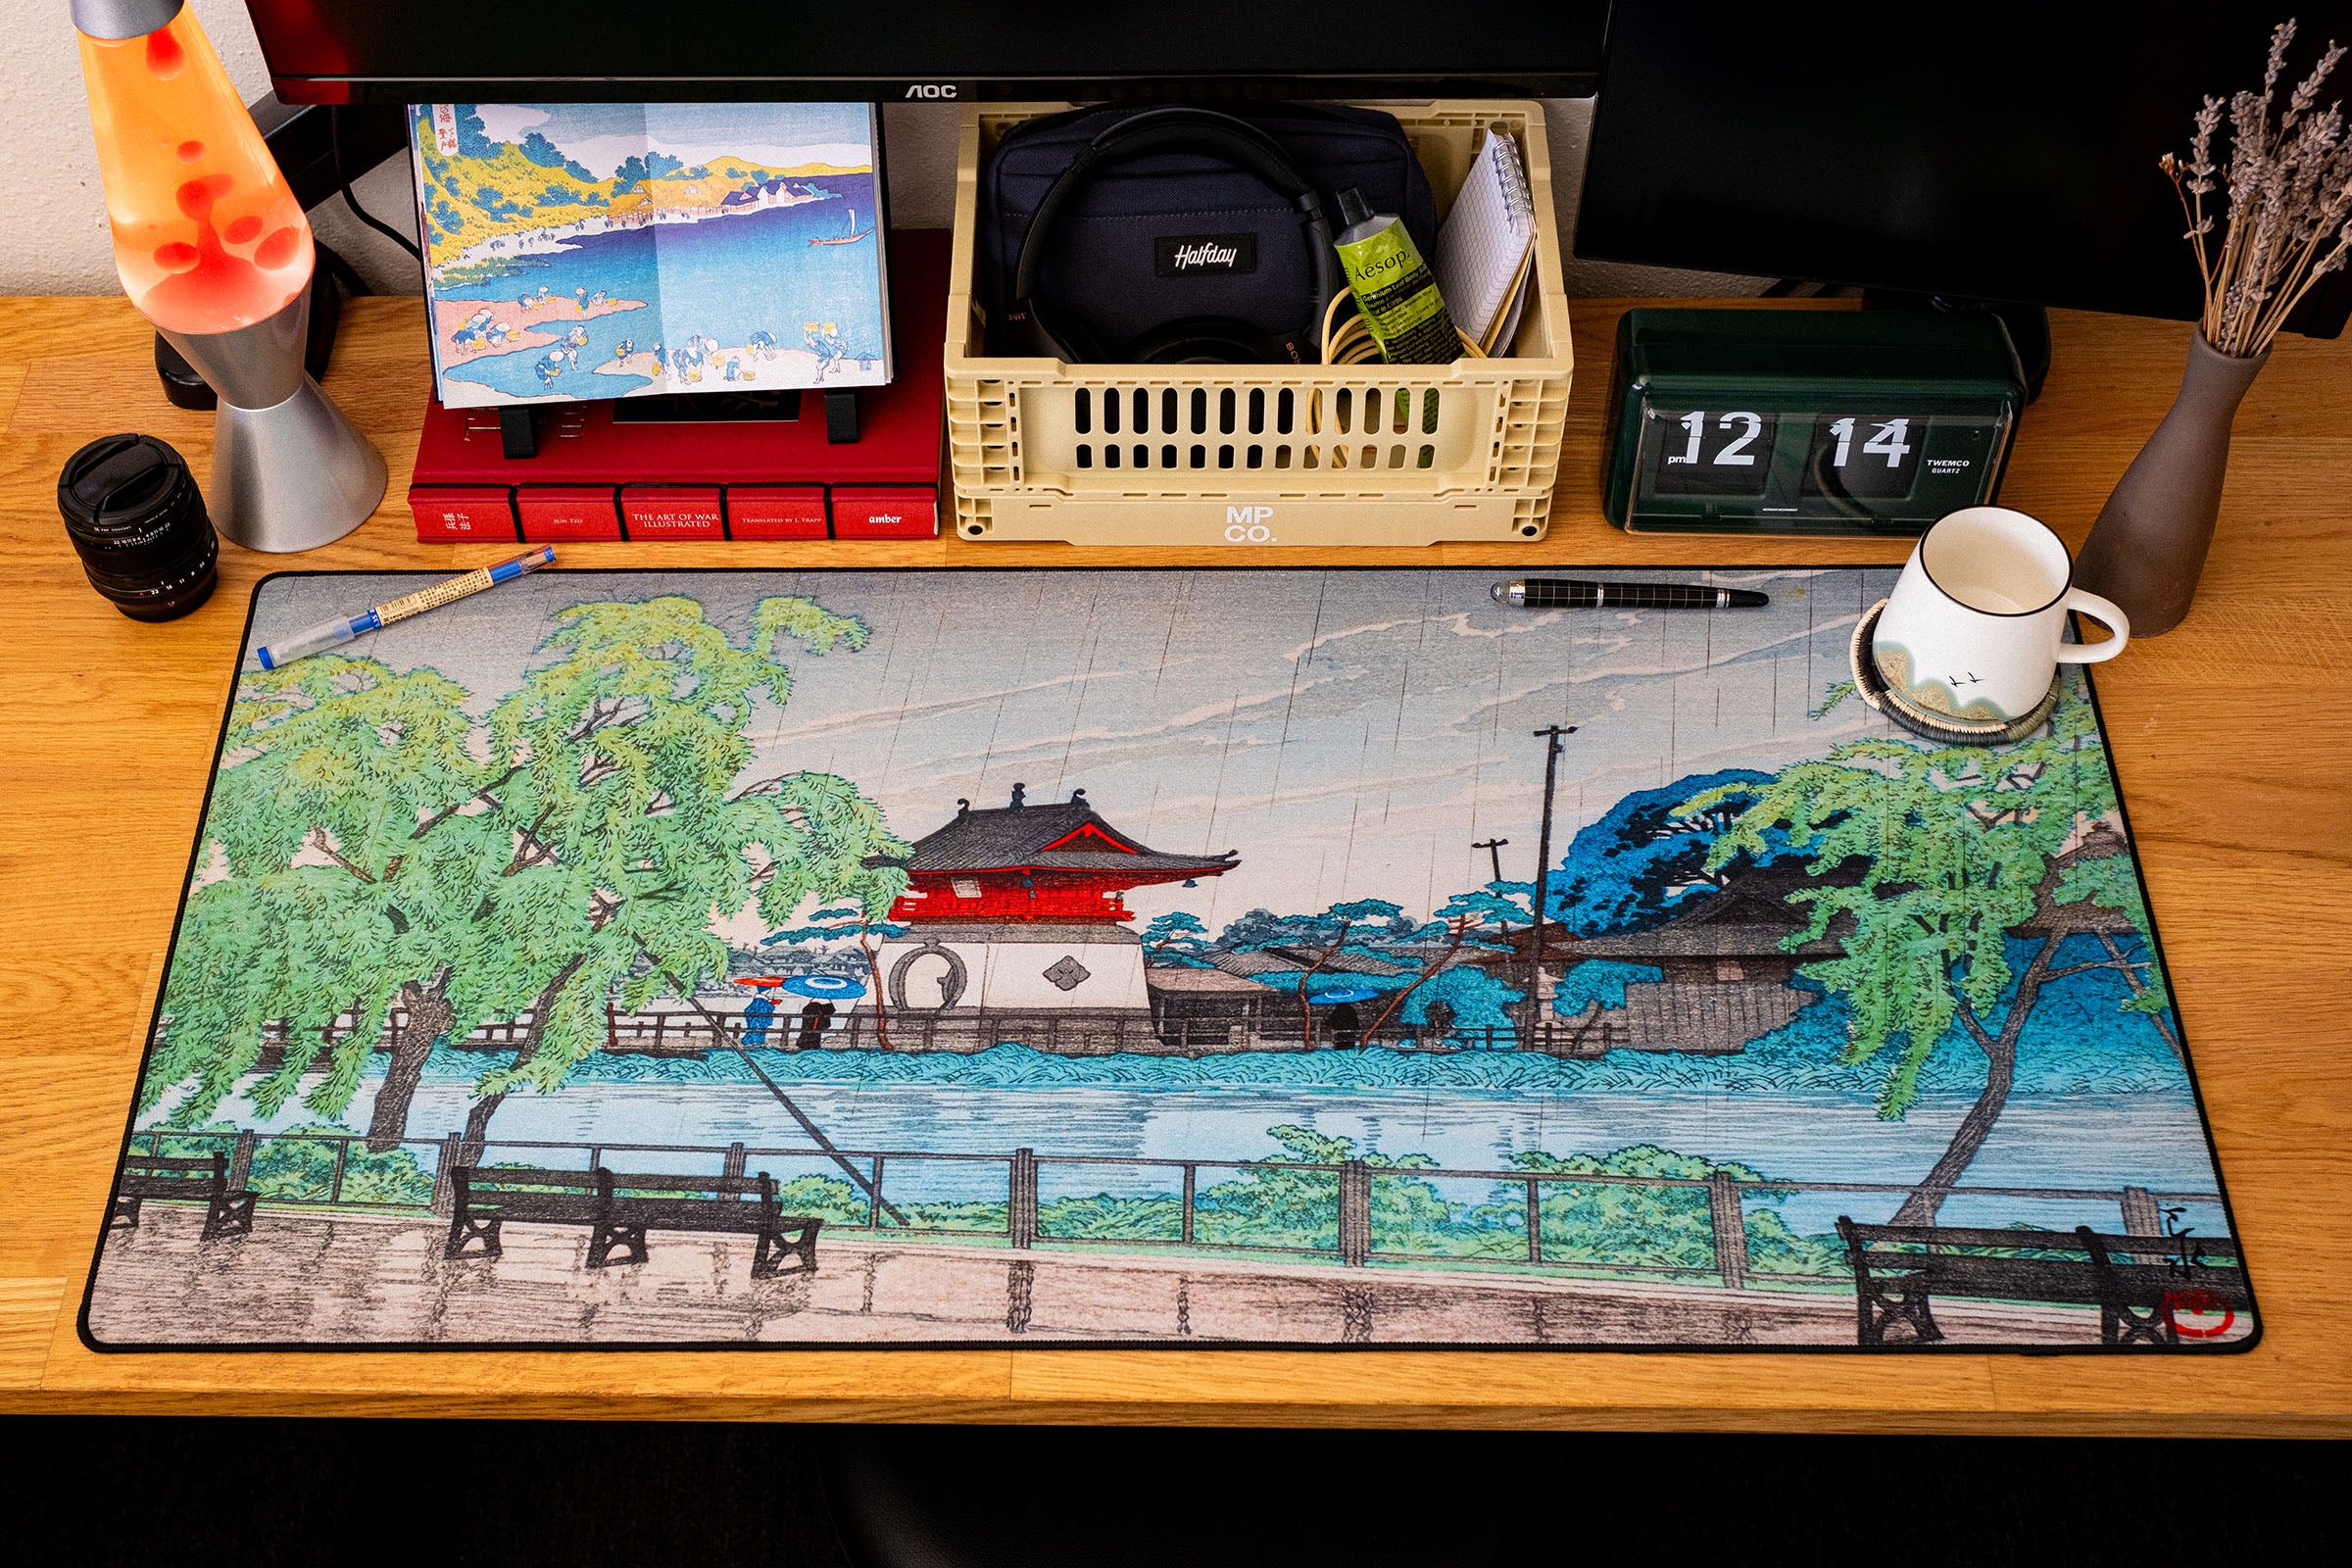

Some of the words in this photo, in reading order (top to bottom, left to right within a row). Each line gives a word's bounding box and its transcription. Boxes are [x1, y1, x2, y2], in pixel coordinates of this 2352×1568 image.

[905, 84, 957, 99] AOC
[1174, 242, 1238, 270] Halfday
[1680, 412, 1762, 466] 12
[1830, 417, 1910, 468] 14
[1927, 459, 1970, 467] TWEMCO
[696, 513, 718, 521] WAR
[868, 514, 903, 524] amber
[1226, 506, 1274, 523] MP
[643, 519, 710, 528] ILLUSTRATED
[1224, 524, 1278, 543] CO.
